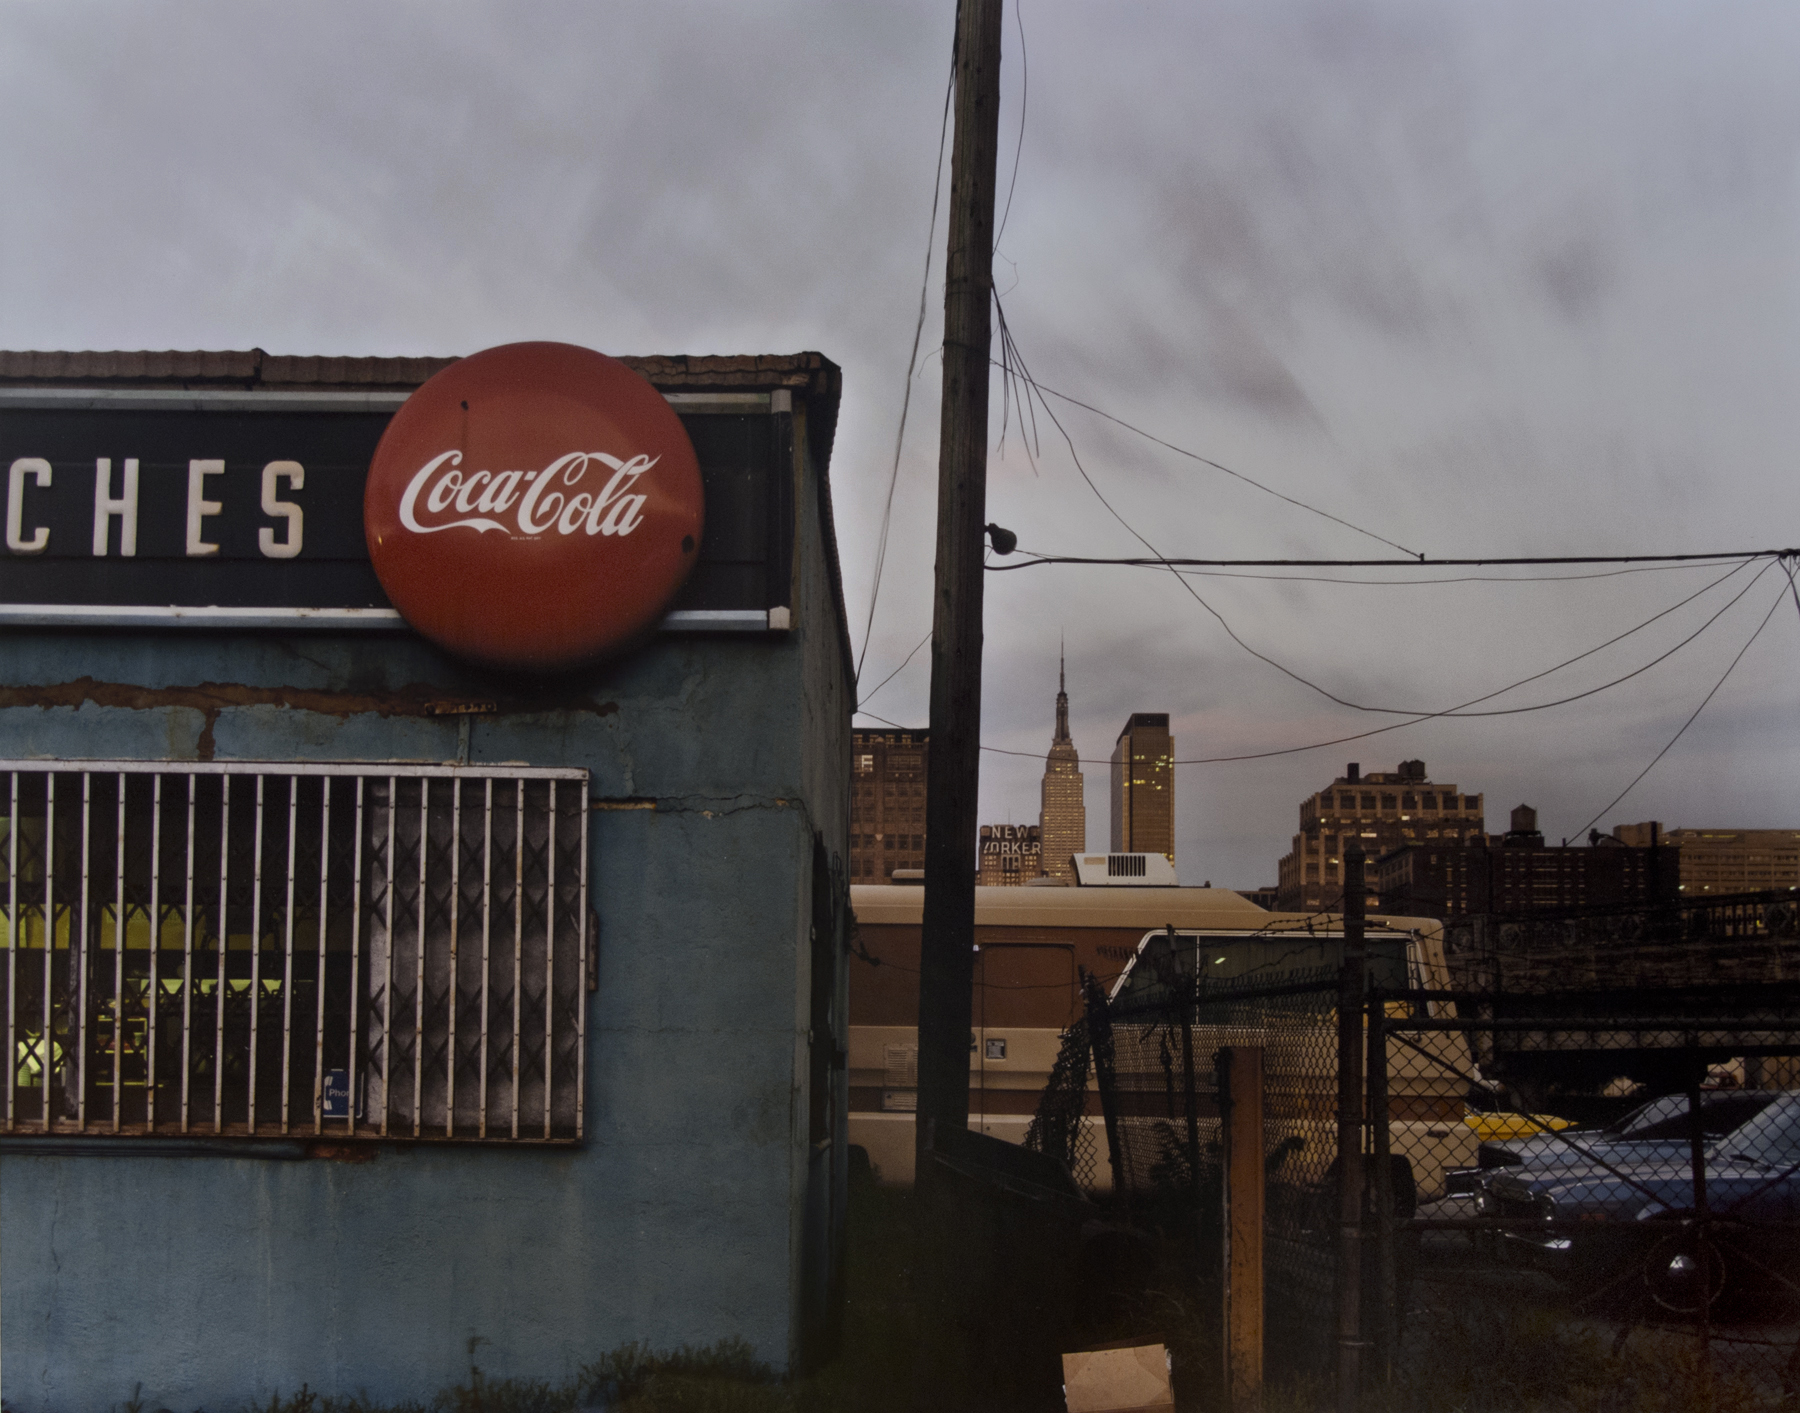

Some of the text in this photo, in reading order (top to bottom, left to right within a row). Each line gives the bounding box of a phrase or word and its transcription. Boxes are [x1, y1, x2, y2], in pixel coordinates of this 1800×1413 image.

[6, 457, 305, 559] CHES
[399, 449, 662, 537] Coca-Cola
[991, 826, 1029, 839] NEW
